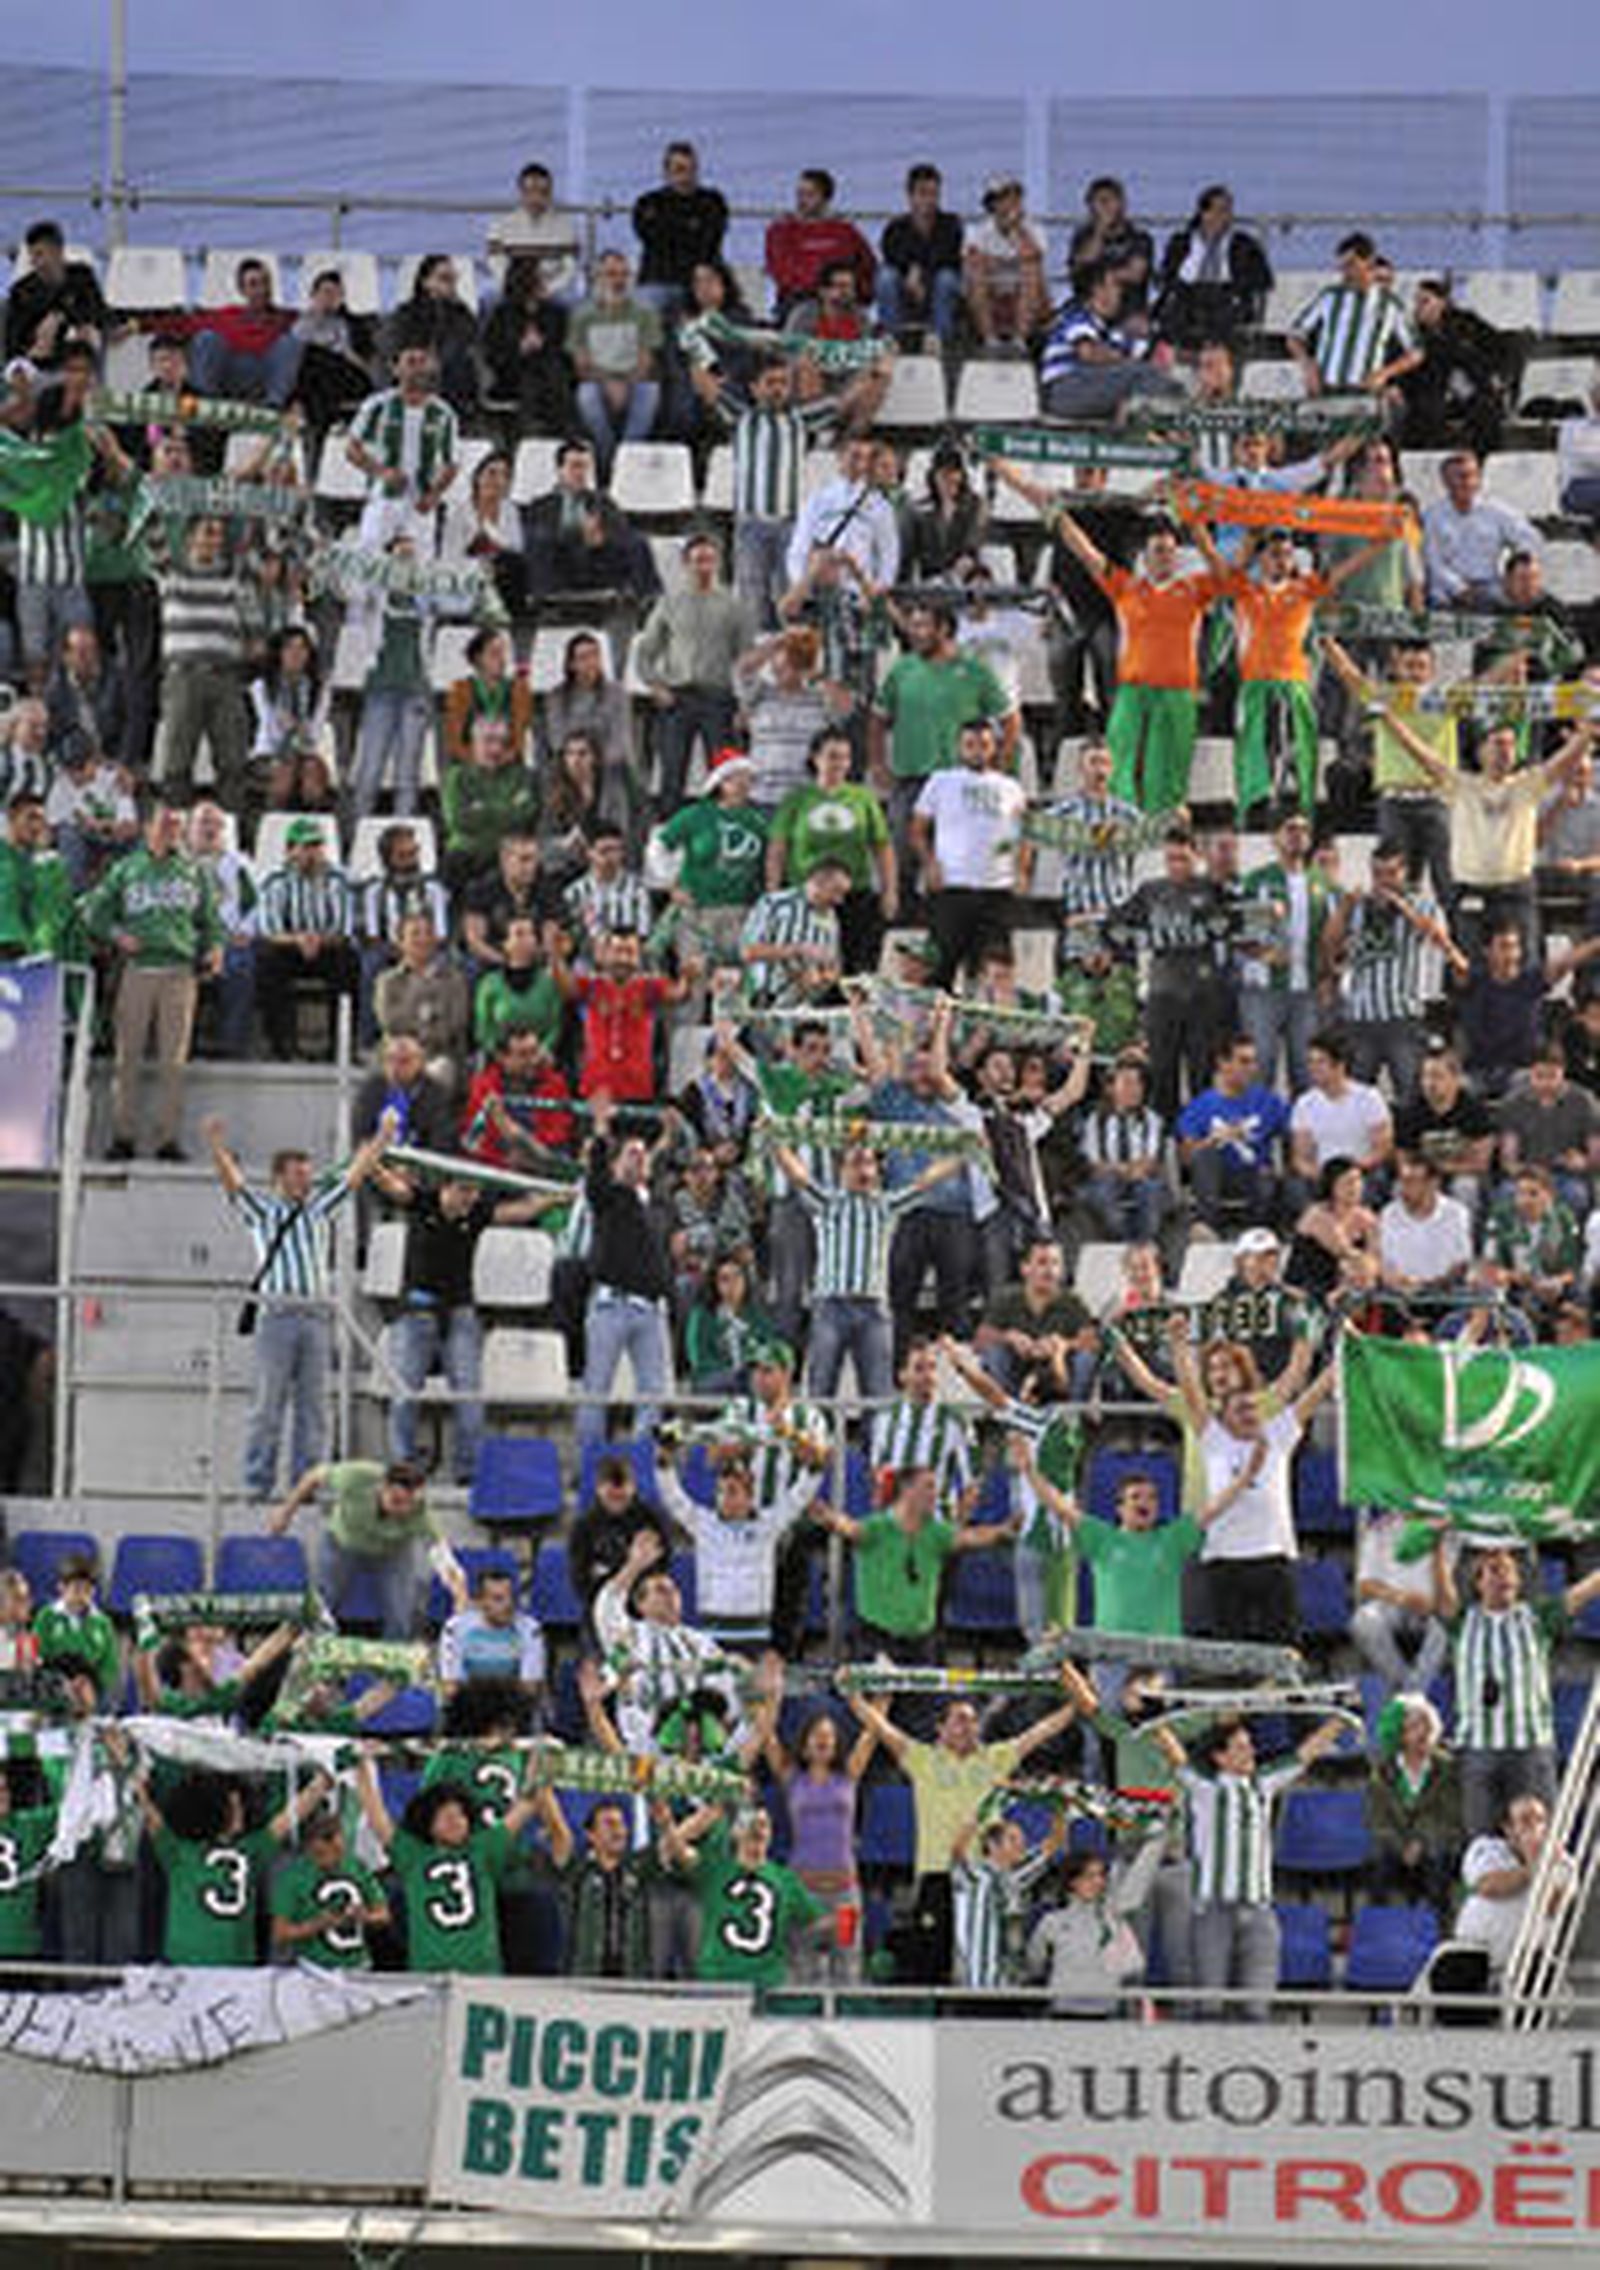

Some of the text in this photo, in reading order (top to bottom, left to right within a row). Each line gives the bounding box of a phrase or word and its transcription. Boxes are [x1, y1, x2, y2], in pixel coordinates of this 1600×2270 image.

[477, 1763, 517, 1827] 3
[204, 1848, 248, 1916] 3
[428, 1862, 475, 1926] 3
[723, 1880, 774, 1953] 3
[997, 2040, 1600, 2133] autoinsul
[462, 2098, 702, 2188] BETIS
[1020, 2141, 1600, 2229] CITROË
